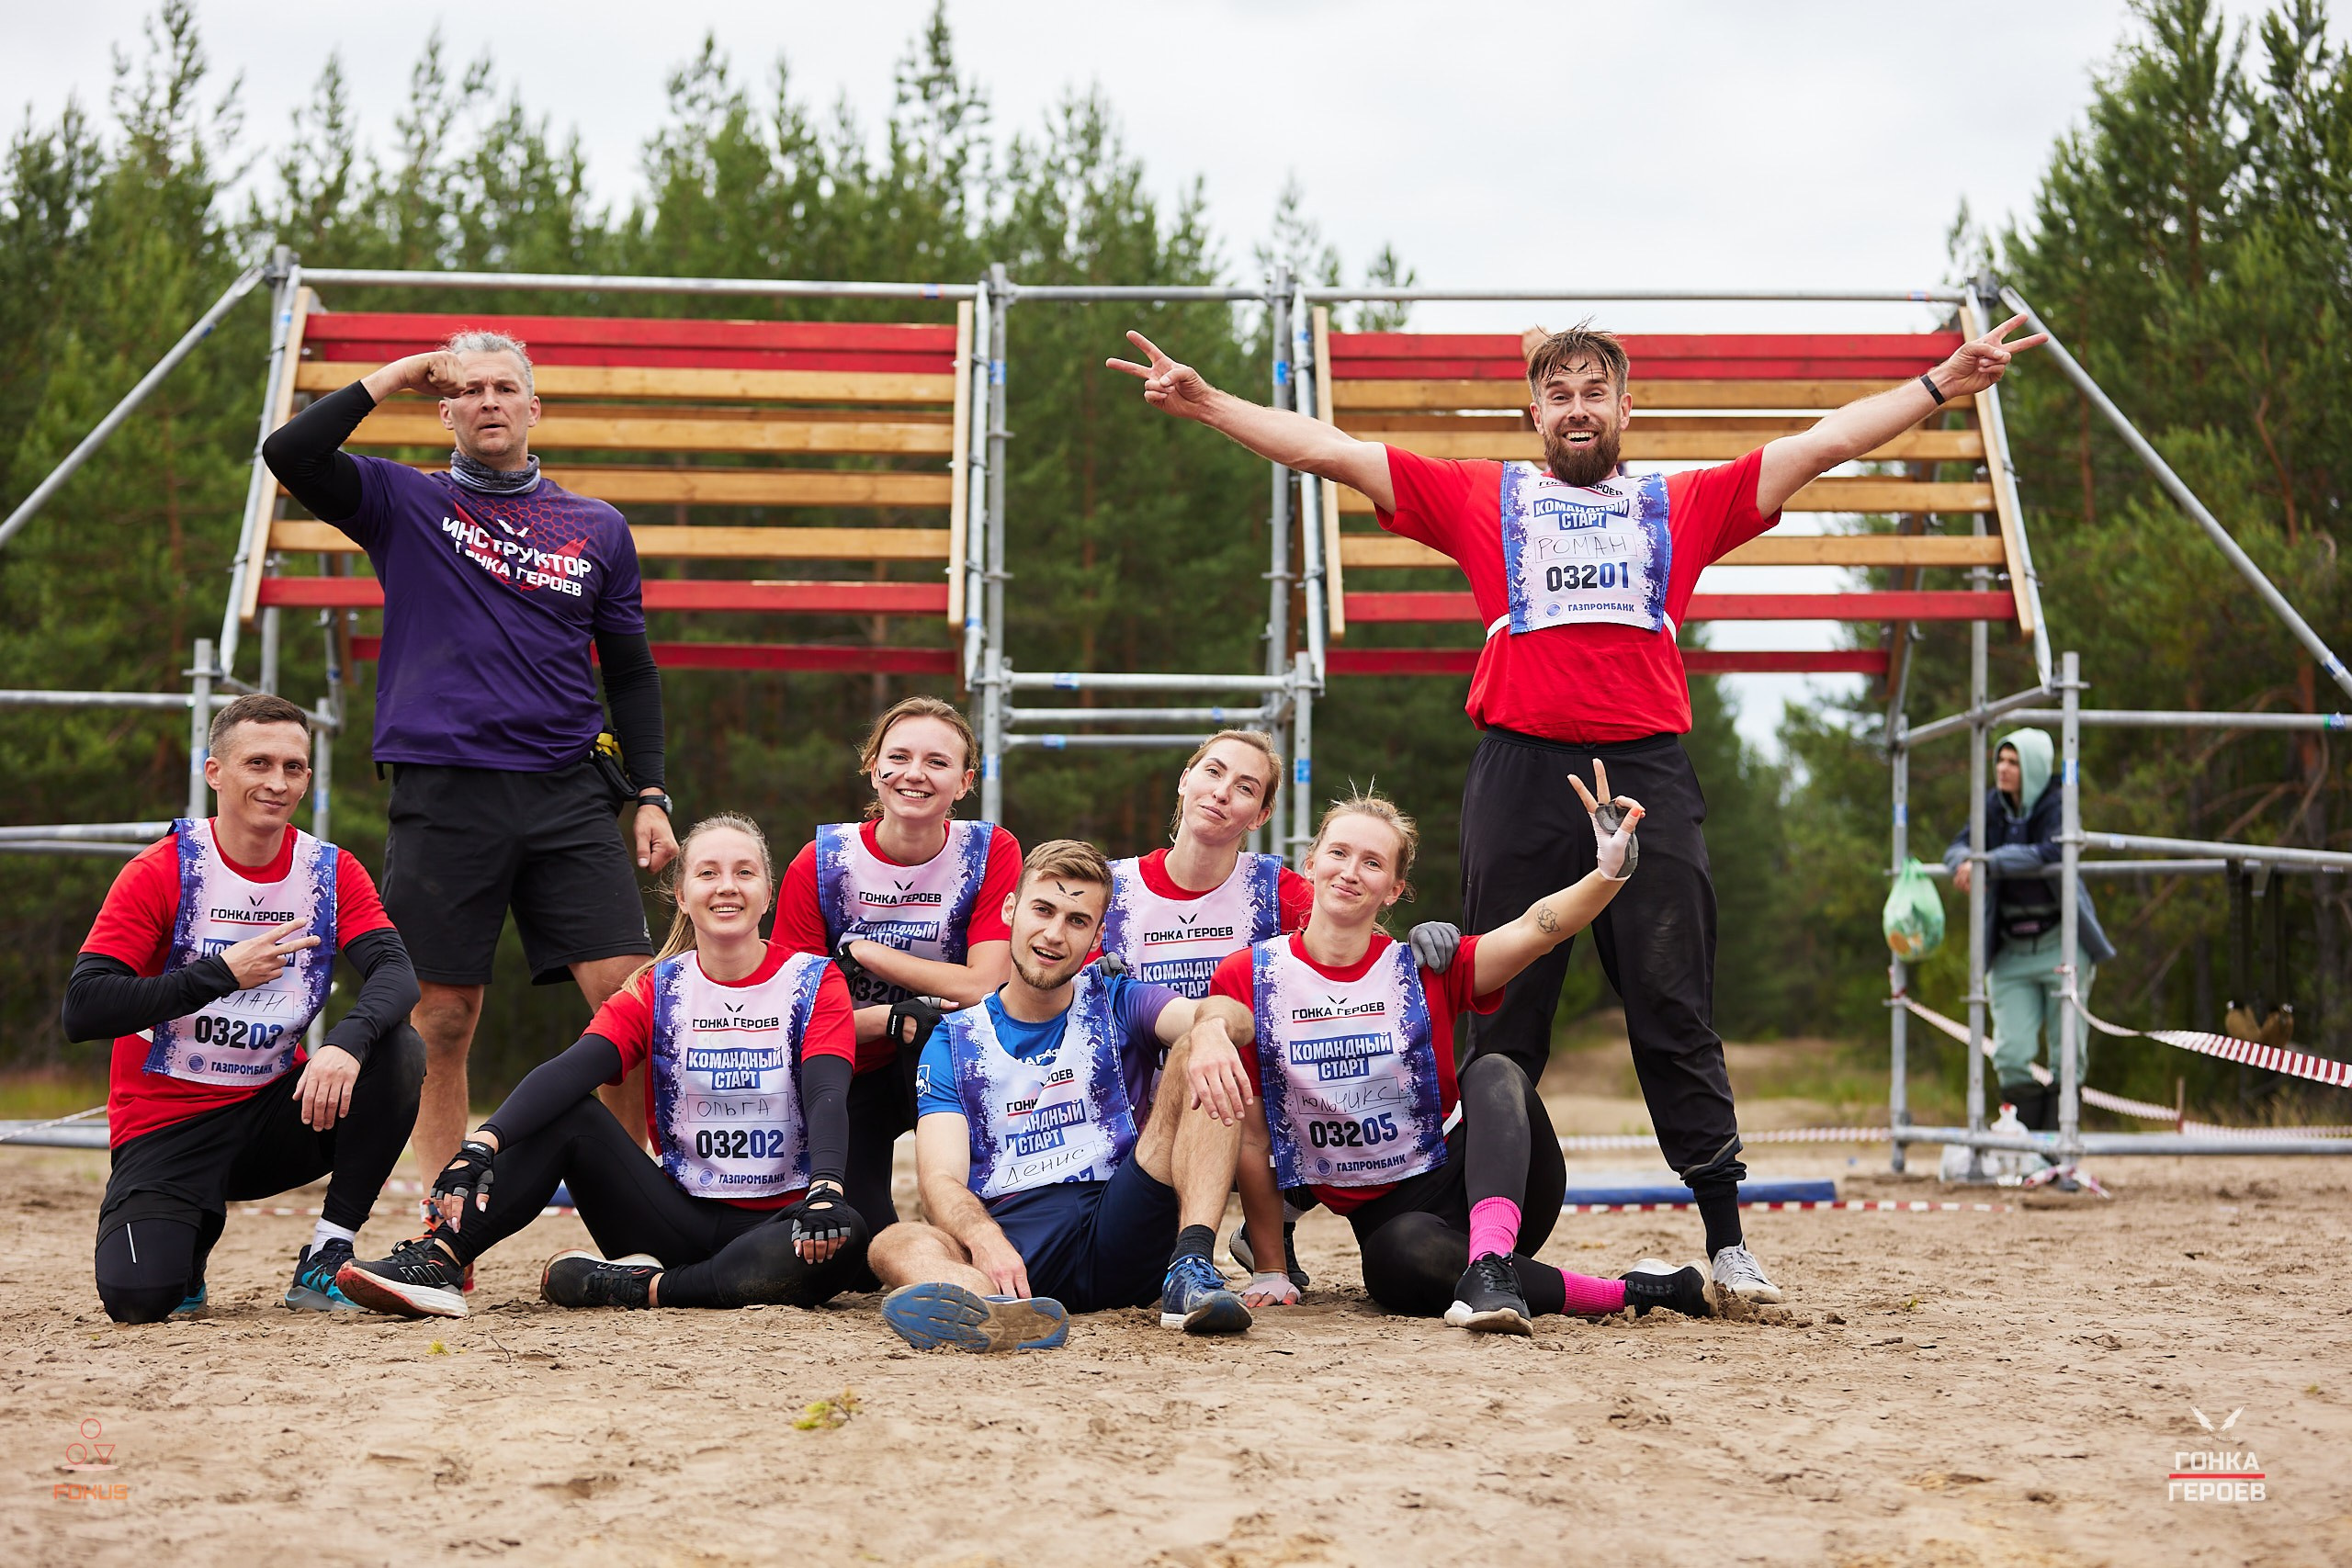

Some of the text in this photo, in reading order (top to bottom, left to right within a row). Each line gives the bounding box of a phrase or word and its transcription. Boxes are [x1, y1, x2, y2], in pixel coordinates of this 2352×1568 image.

[1535, 498, 1629, 516] КОМАНДНЫЙ
[1562, 513, 1605, 529] СТАРТ
[442, 517, 593, 579] ИНСТРУКТОР
[1538, 536, 1627, 560] РОМАН
[515, 566, 582, 597] ГЕРОЕВ
[1545, 561, 1629, 592] 03201
[1567, 603, 1635, 614] ГАЗПРОМБАНК
[859, 891, 942, 905] ГОНКА ГЕРОЕВ
[210, 908, 295, 921] ГОНКА ГЕРОЕВ
[1144, 926, 1234, 942] ГОНКА ГЕРОЕВ
[1143, 960, 1218, 983] КОМАНДН
[1293, 1002, 1385, 1020] ГОНКА ГЕРОЕВ
[195, 1015, 284, 1050] 03203
[693, 1017, 779, 1029] ГОНКА ГЕРОЕВ
[1292, 1032, 1391, 1061] КОМАНДНЫЙ
[689, 1045, 783, 1070] КОМАНДНЫЙ
[210, 1061, 273, 1075] ГАЗПРОМБАНК
[1320, 1058, 1365, 1078] СТАРТ
[715, 1070, 757, 1089] СТАРТ
[1022, 1099, 1084, 1134] АНДНЫЙ
[1309, 1112, 1398, 1148] 03205
[696, 1129, 785, 1159] 03202
[1017, 1128, 1061, 1156] СТАРТ
[1337, 1154, 1407, 1172] ГАЗПРОМБАНК
[718, 1173, 786, 1185] ГАЗПРОМБАНК
